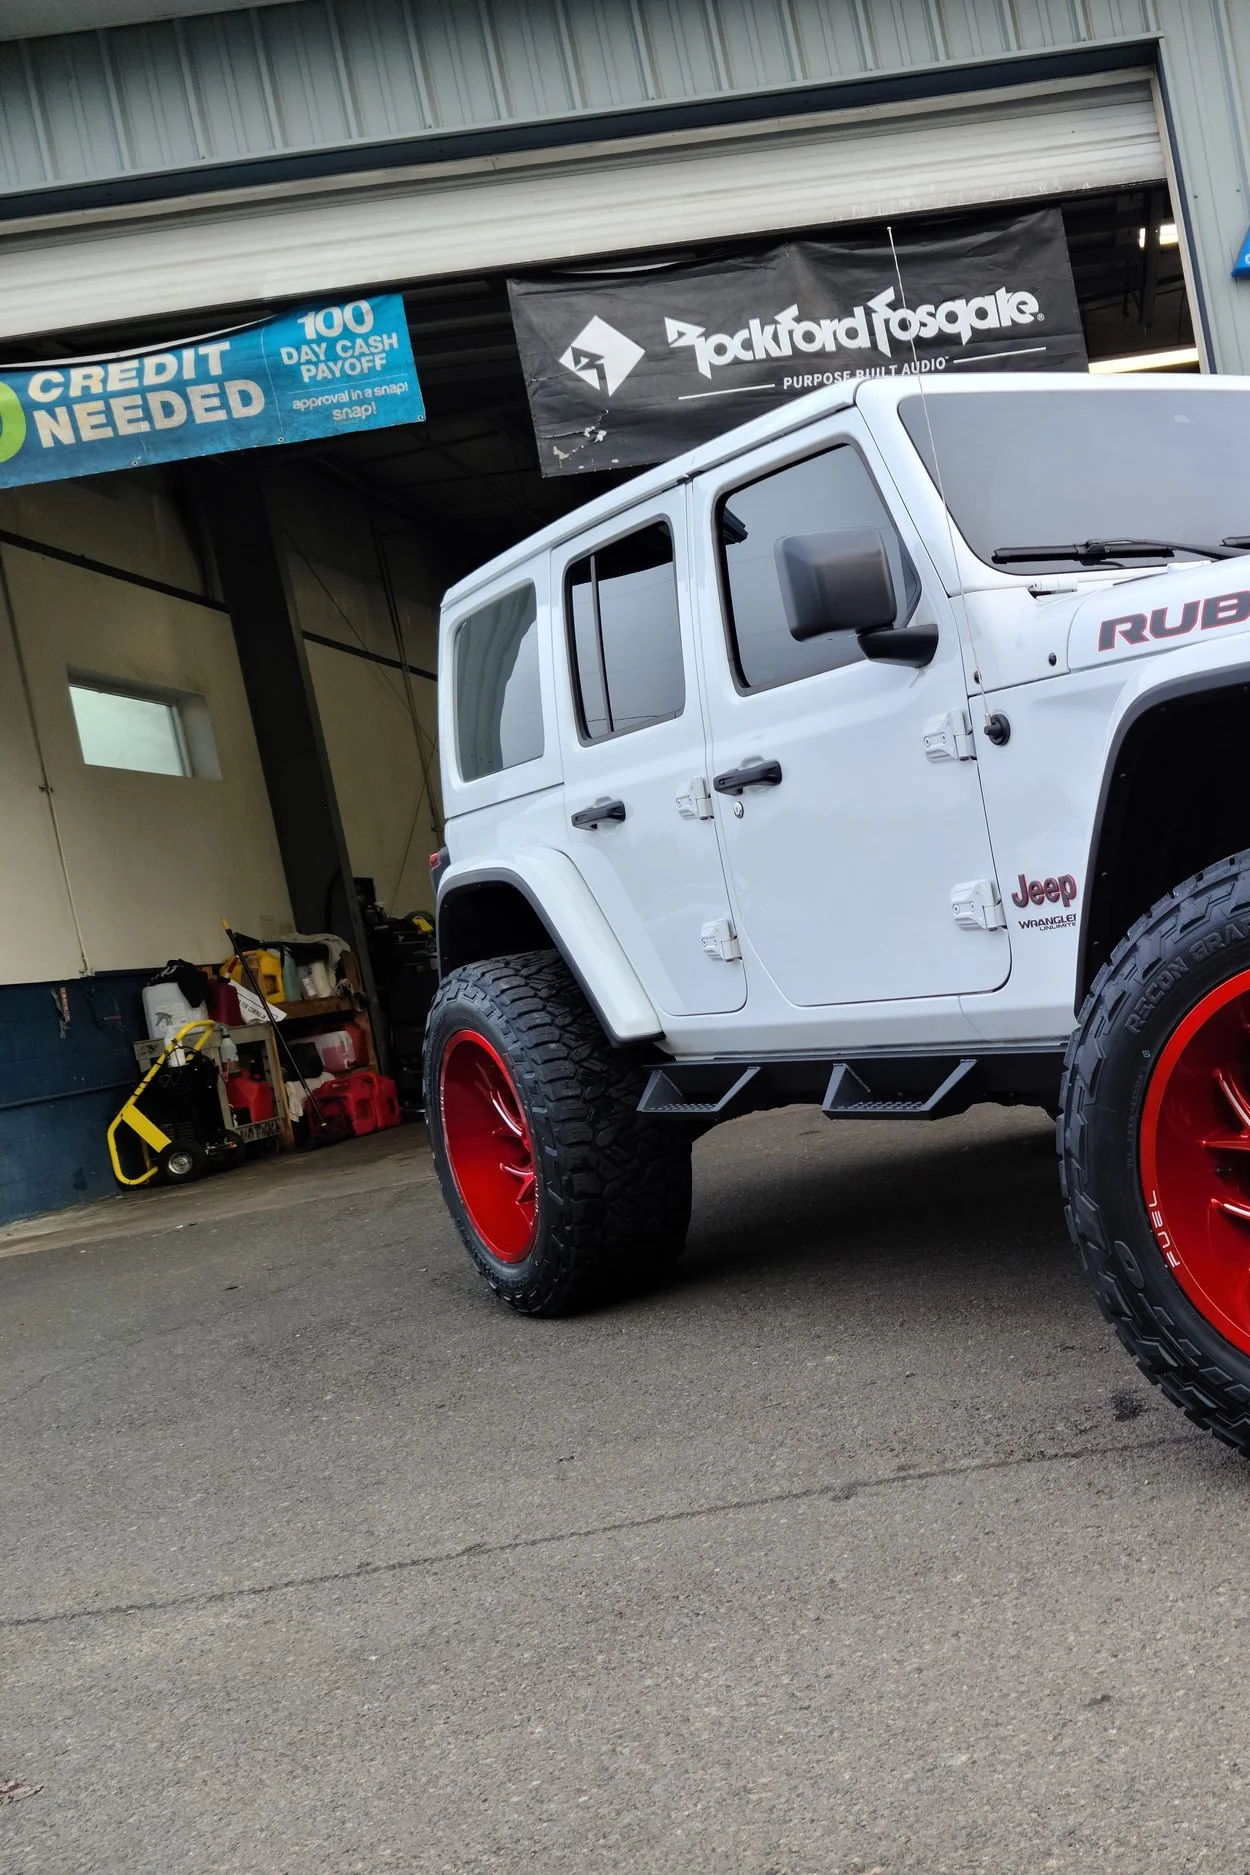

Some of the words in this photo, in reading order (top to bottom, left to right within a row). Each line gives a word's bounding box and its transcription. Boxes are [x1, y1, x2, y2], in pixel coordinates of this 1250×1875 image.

[297, 299, 374, 340] 100
[664, 303, 871, 379] Rockford
[866, 286, 1039, 359] Fosgate
[280, 342, 327, 365] DAY
[336, 332, 399, 358] CASH
[28, 341, 230, 403] CREDIT
[299, 353, 387, 383] PAYOFF
[783, 370, 850, 390] PURPOSE
[856, 365, 898, 379] BUILT
[902, 357, 946, 376] AUDIO
[33, 379, 265, 448] NEEDED
[292, 389, 349, 412] approval
[351, 389, 363, 401] in
[364, 387, 374, 398] a
[374, 382, 409, 397] snap!
[332, 401, 377, 421] snap!
[1011, 873, 1077, 908] Jeep
[1124, 957, 1190, 1036] RECON
[1149, 1189, 1181, 1268] FUEL
